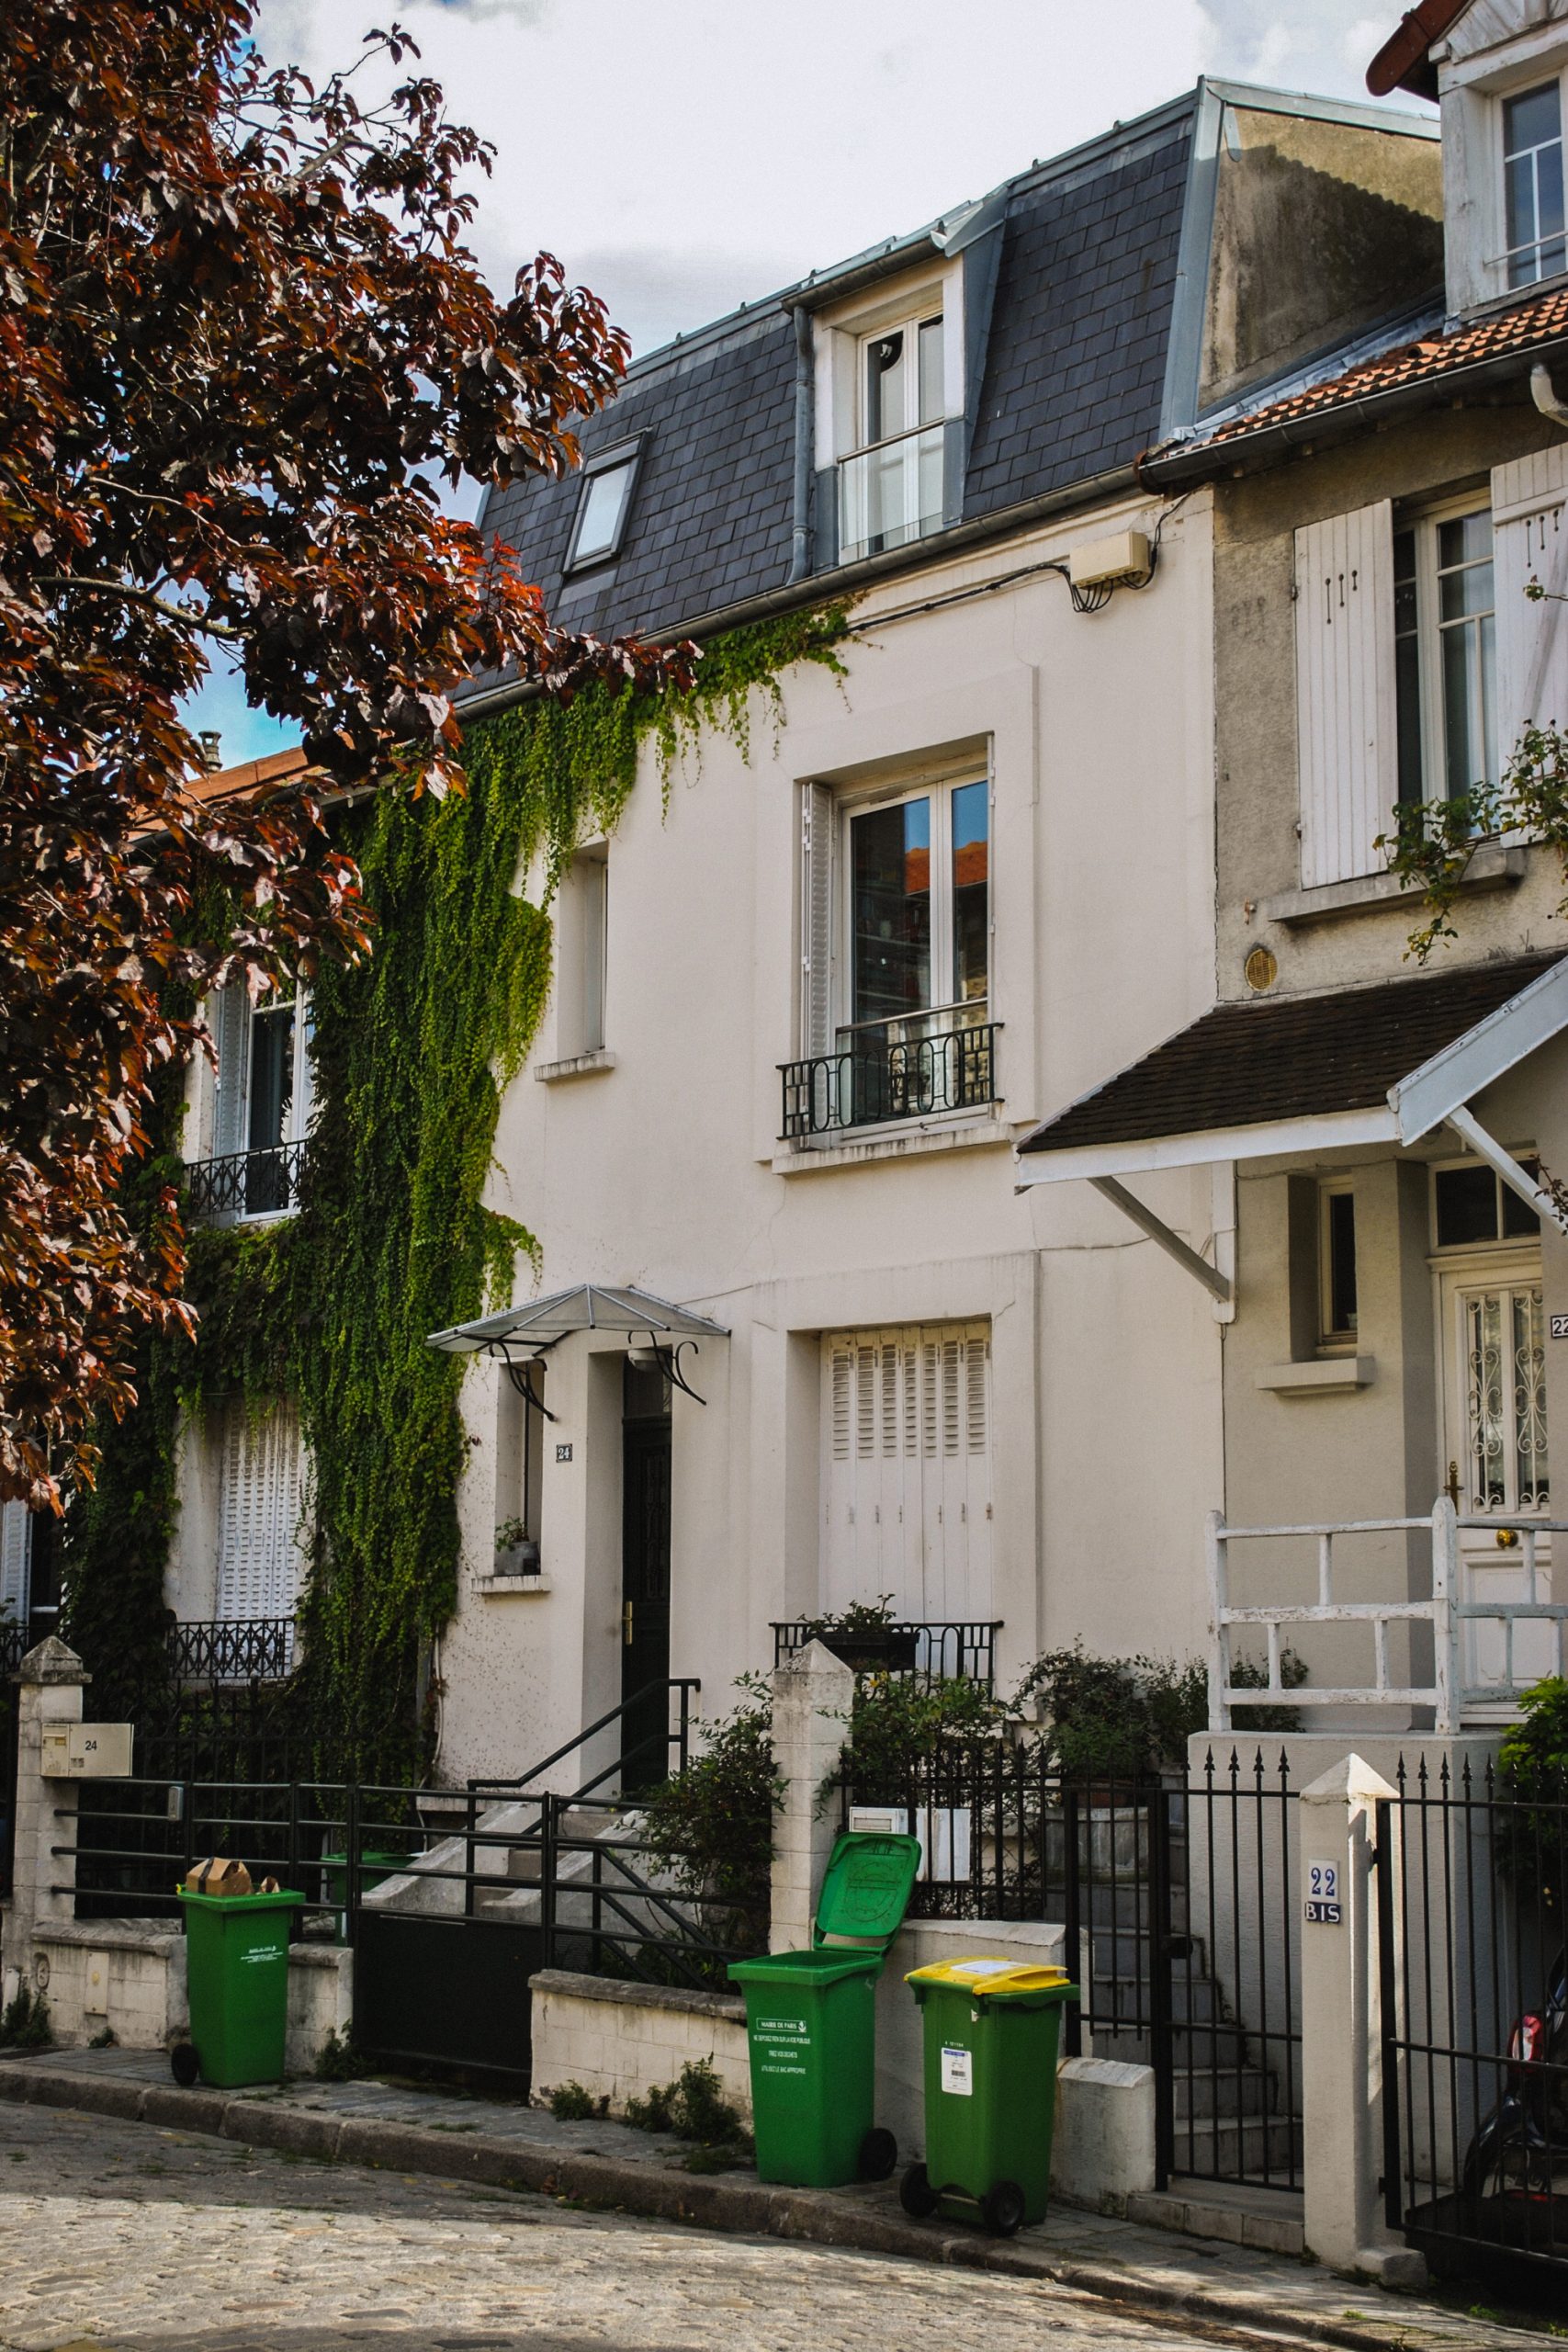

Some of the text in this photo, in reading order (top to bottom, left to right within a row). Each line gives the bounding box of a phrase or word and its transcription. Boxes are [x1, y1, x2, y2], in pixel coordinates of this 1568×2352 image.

[558, 1446, 570, 1459] 24
[85, 1740, 97, 1750] 24
[1311, 1867, 1335, 1896] 22
[1306, 1903, 1339, 1922] BIS
